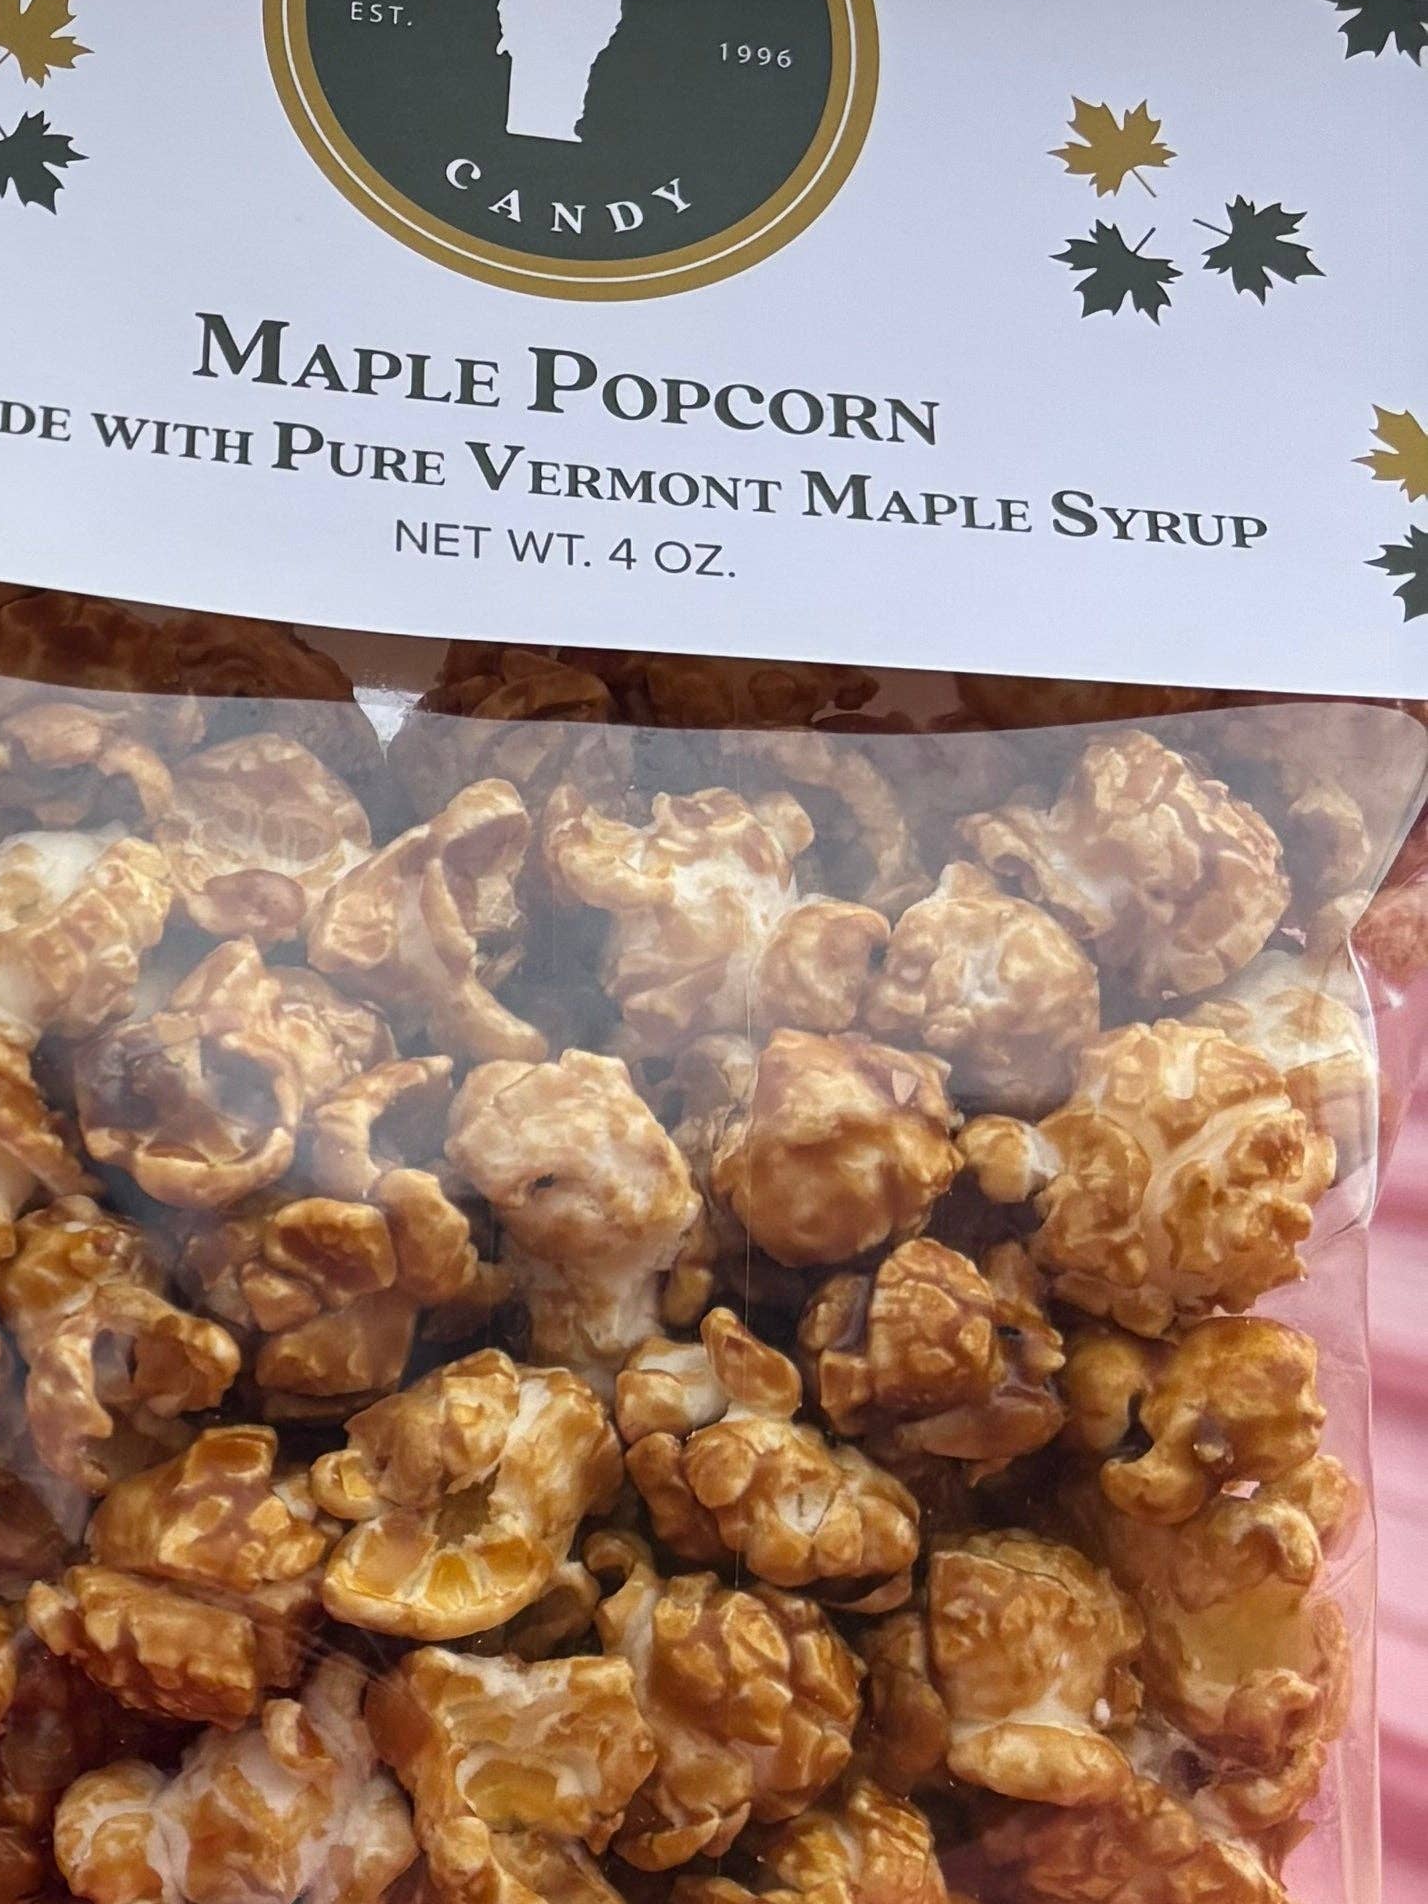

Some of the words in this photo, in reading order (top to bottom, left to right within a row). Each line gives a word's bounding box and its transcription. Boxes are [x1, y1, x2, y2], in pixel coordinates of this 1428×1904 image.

[349, 0, 415, 26] EST.
[719, 41, 794, 70] 1996
[444, 157, 693, 235] CANDY
[191, 312, 501, 408] MAPLE
[526, 346, 941, 446] POPCORN
[91, 412, 254, 466] WITH
[270, 421, 447, 486] PURE
[464, 441, 783, 513] VERMONT
[800, 470, 1033, 533] MAPLE
[1050, 490, 1269, 549] SYRUP
[395, 519, 493, 560] NET
[507, 529, 596, 568] WT.
[608, 538, 638, 571] 4
[654, 541, 738, 579] OZ.
